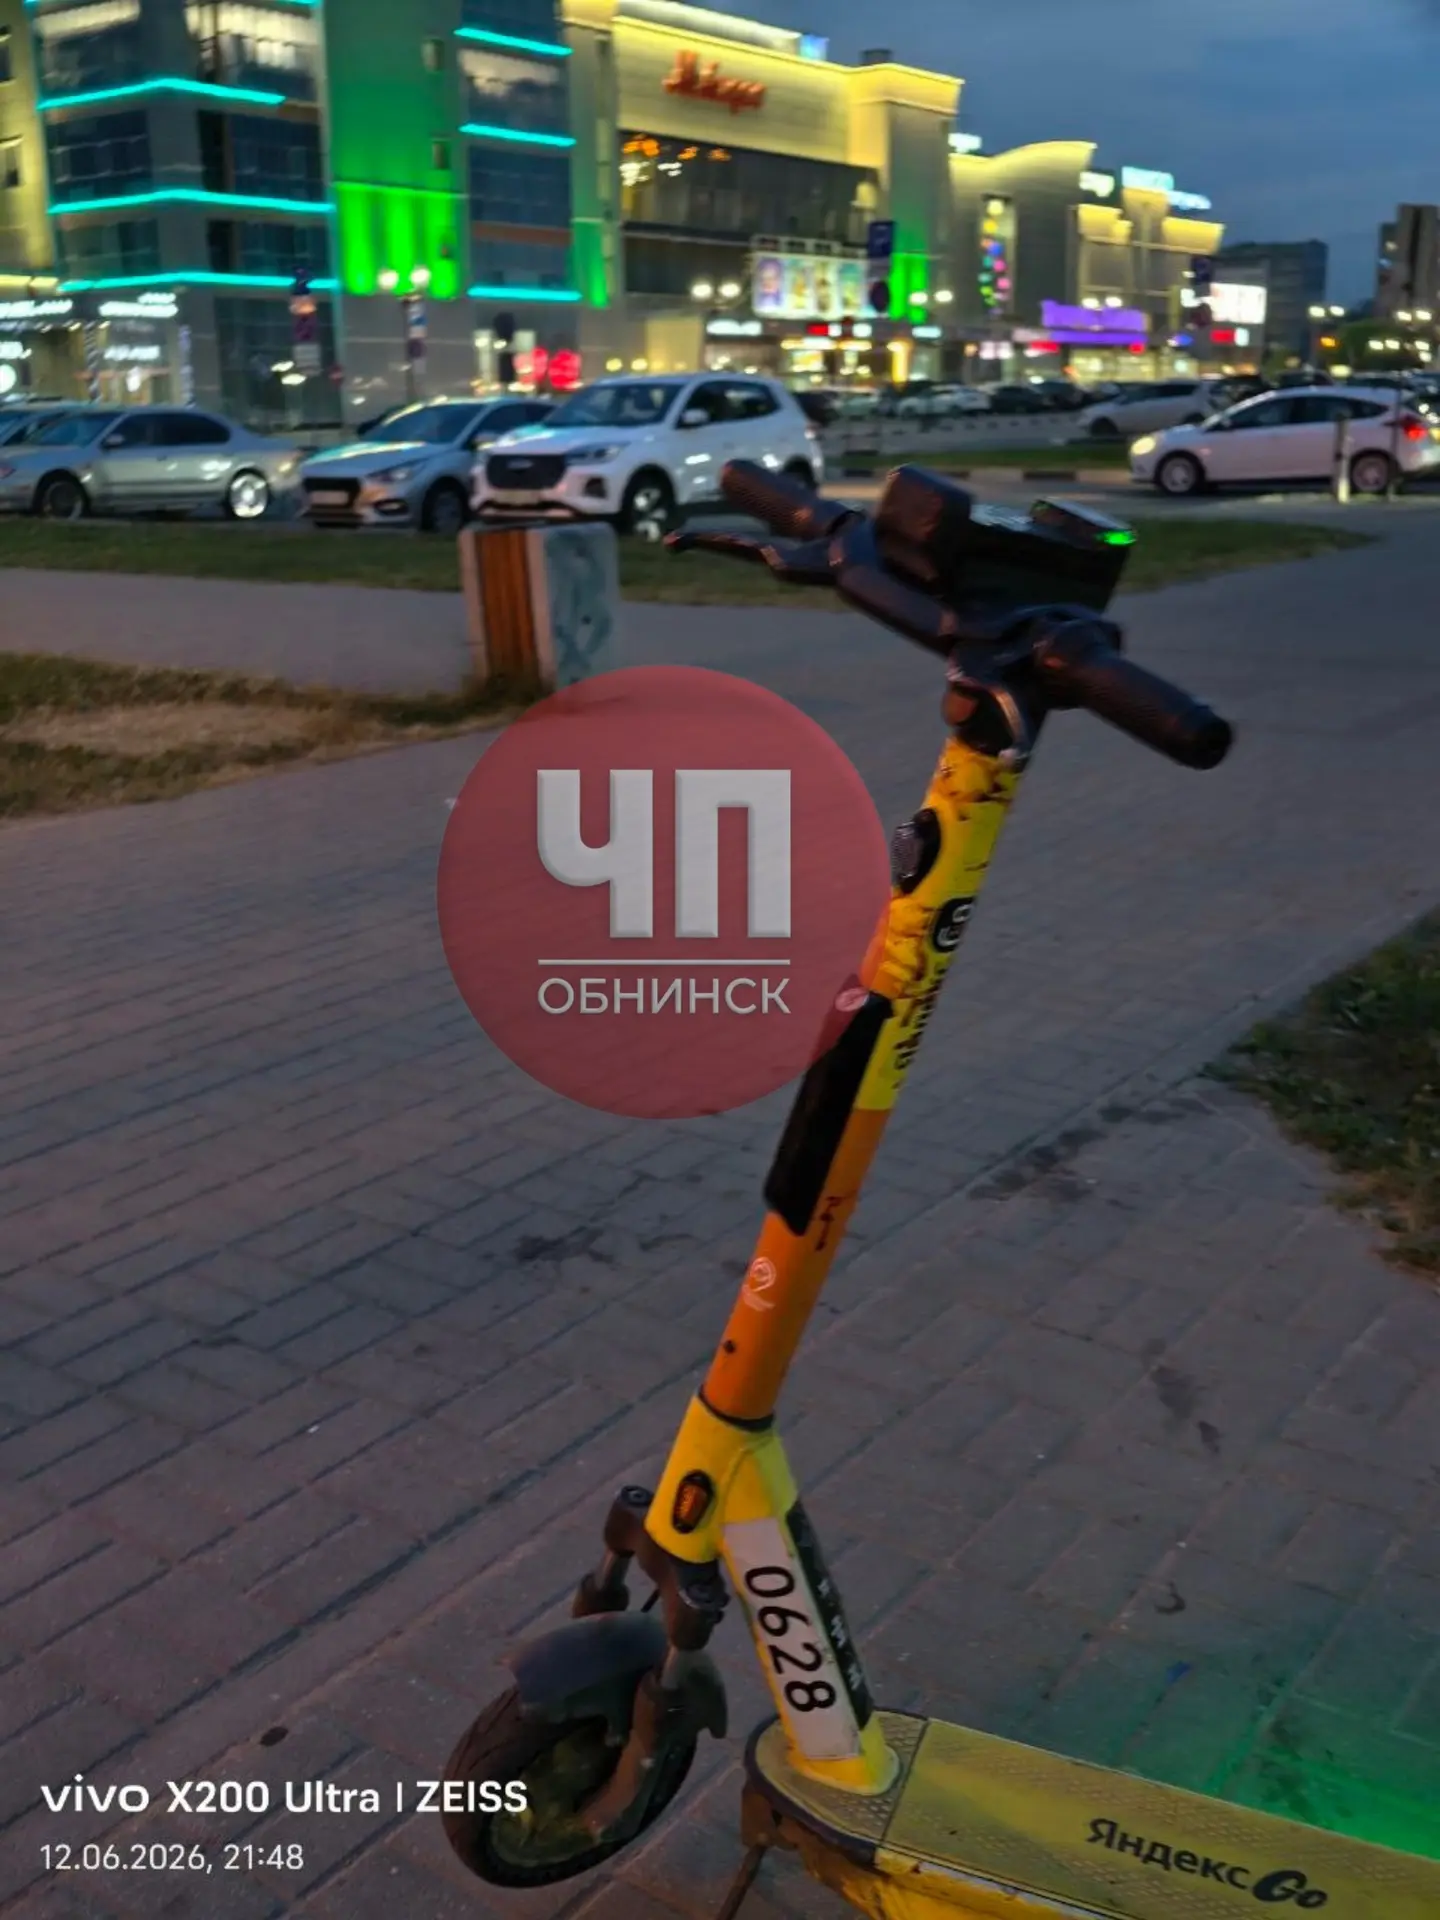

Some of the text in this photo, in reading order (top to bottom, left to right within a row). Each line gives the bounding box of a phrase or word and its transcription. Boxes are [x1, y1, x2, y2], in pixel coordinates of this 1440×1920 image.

[744, 1566, 836, 1712] 0628
[1086, 1818, 1329, 1908] Яндекс Go
